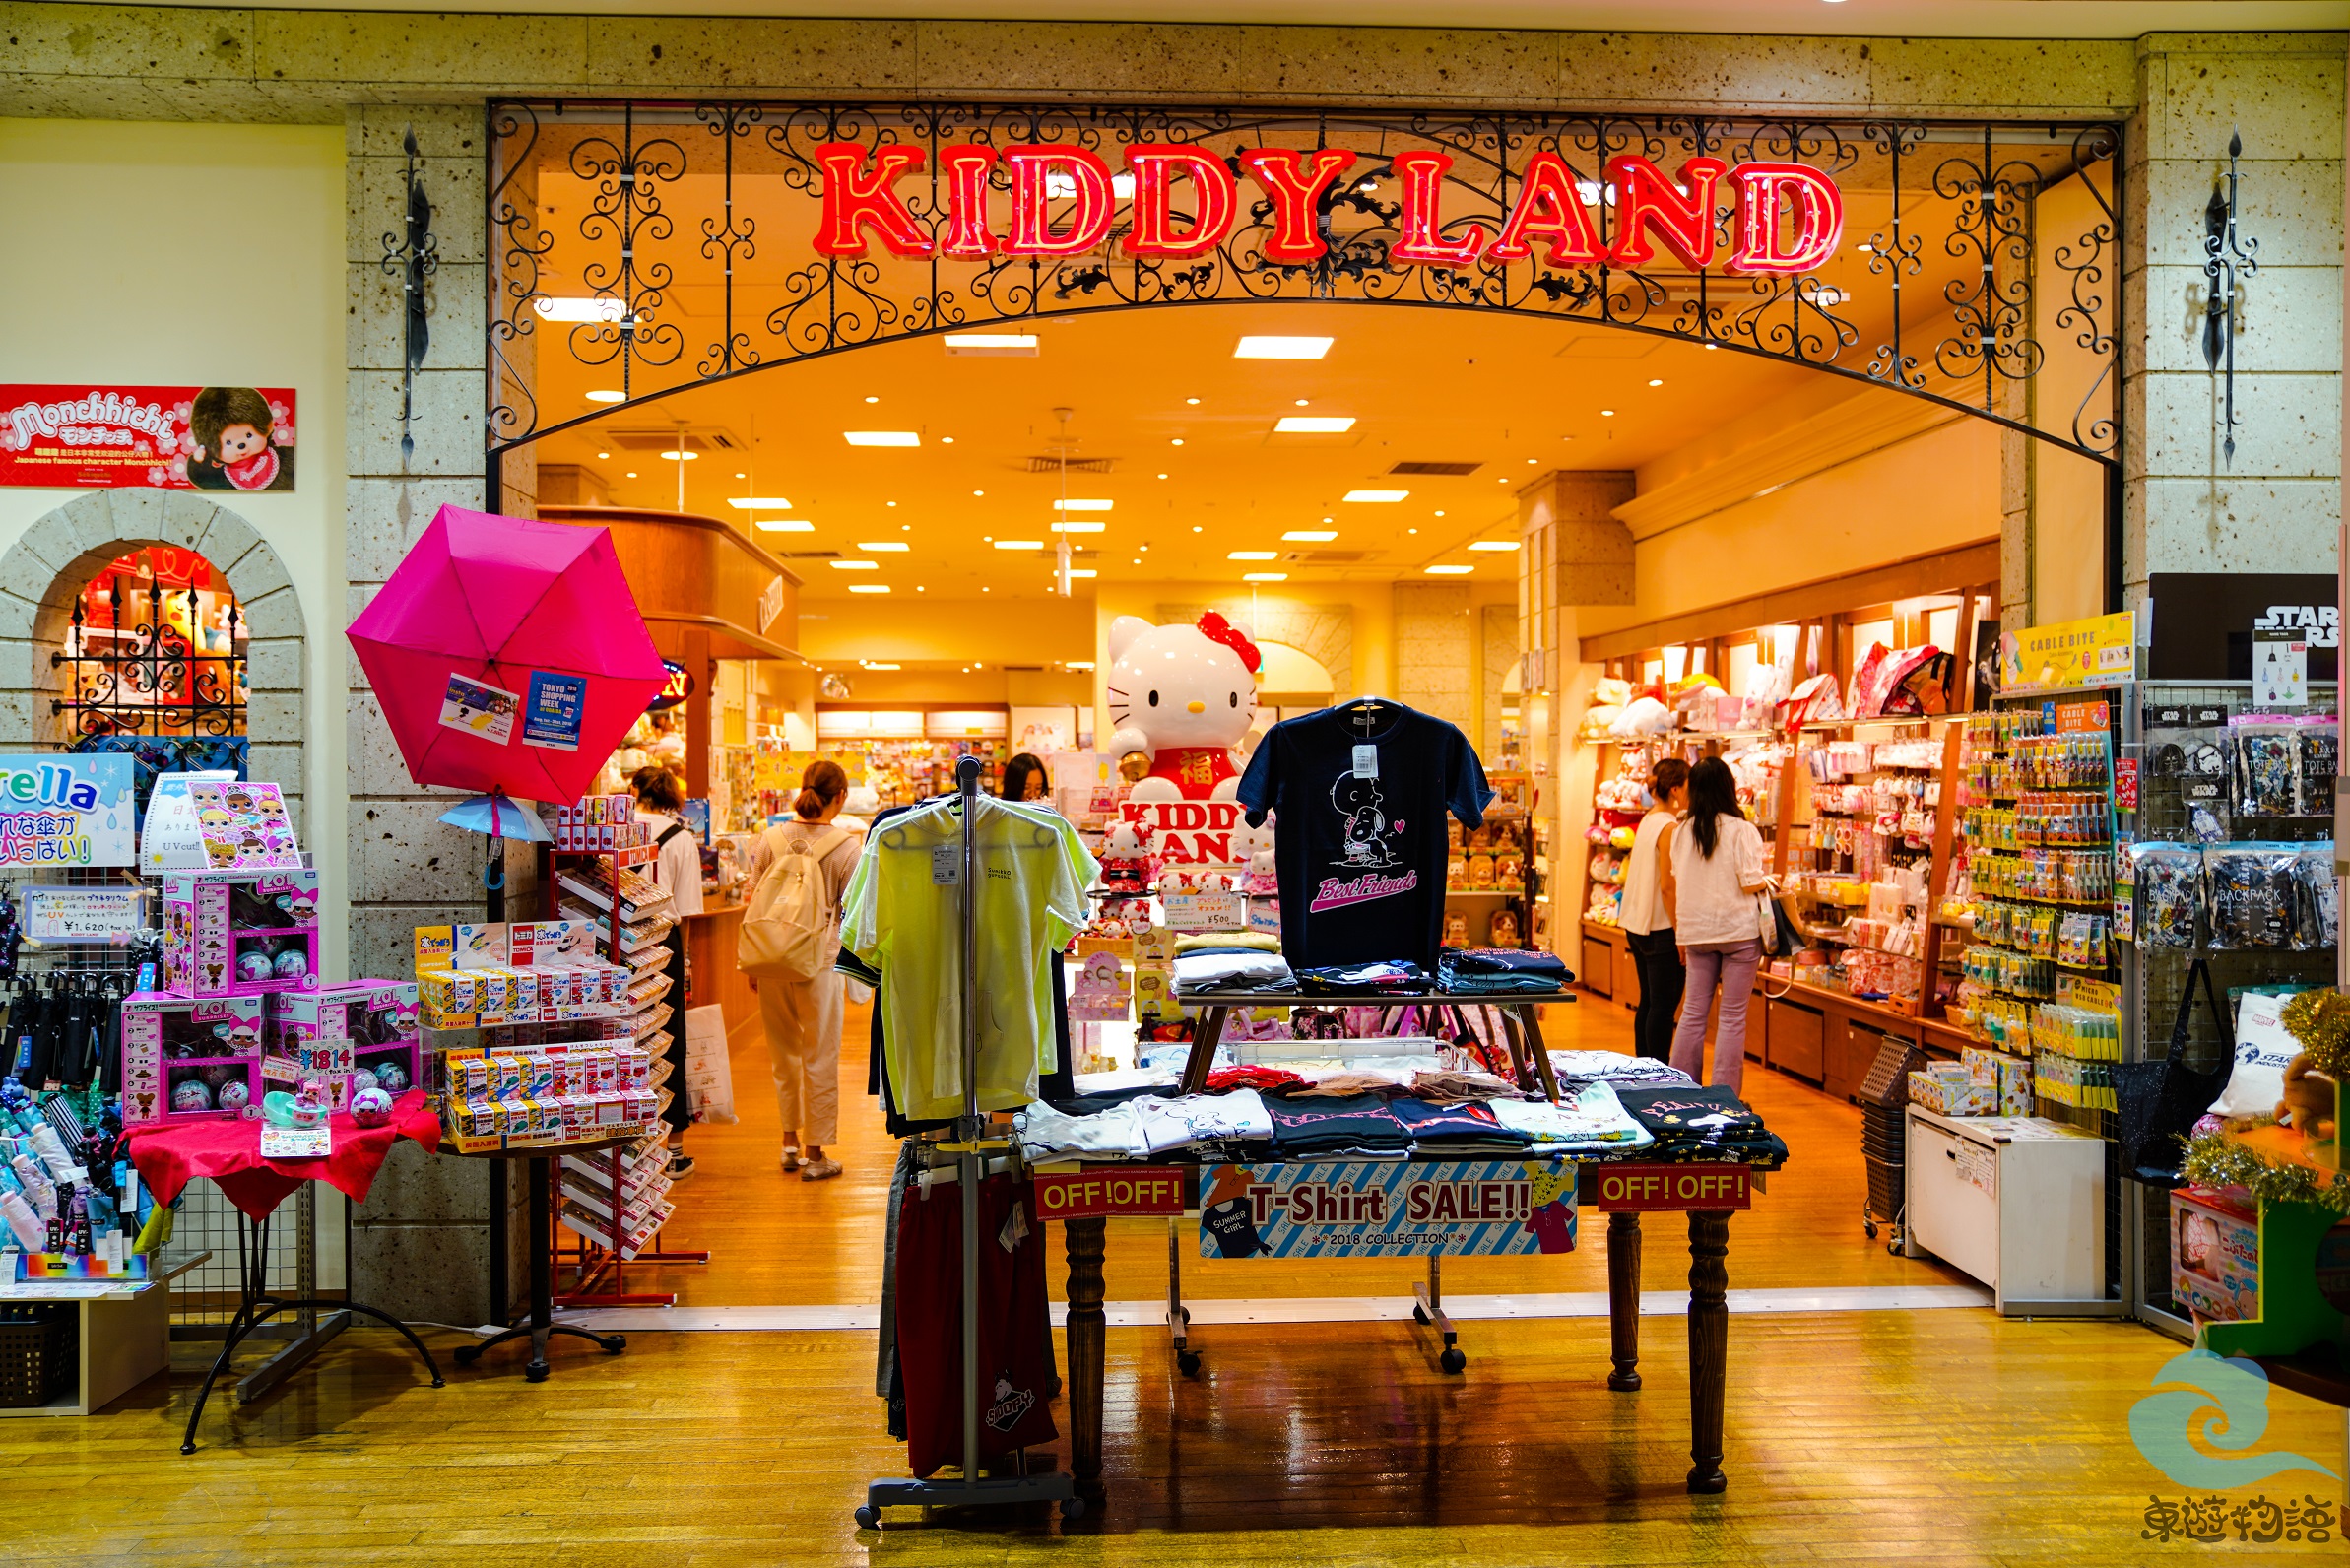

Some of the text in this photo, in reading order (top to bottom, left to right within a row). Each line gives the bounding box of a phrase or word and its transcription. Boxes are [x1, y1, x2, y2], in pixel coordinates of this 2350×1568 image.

[812, 143, 1845, 277] KIDDY LAND
[11, 392, 175, 450] Monchhichi
[60, 427, 133, 445] モンチッチ
[2254, 606, 2338, 627] STAR
[2030, 631, 2095, 652] CABLE BITE
[2254, 626, 2338, 647] RS
[541, 691, 576, 703] SHOPPING
[542, 684, 565, 693] TOKYO
[540, 699, 559, 708] WEEK
[2061, 709, 2085, 718] CABLE
[2065, 718, 2082, 727] BITE
[1180, 751, 1212, 784] 福
[2305, 760, 2324, 770] TOTE
[1121, 803, 1249, 830] KIDD
[262, 873, 296, 887] LOL
[1317, 870, 1418, 900] Best Friends
[2148, 889, 2192, 902] BACKPAC
[2219, 889, 2281, 902] BACKPACK
[1208, 915, 1229, 924] ¥500
[514, 931, 533, 941] トミカ
[537, 929, 562, 940] 水でっぽう
[373, 989, 400, 1005] LOL
[2081, 986, 2098, 996] MICRO
[197, 1001, 234, 1016] LOL
[2086, 996, 2104, 1006] CABLE
[300, 1049, 352, 1070] ¥1814
[2260, 1054, 2293, 1064] STAR
[1280, 1165, 1297, 1185] SALE
[1405, 1164, 1421, 1184] SALE
[1044, 1180, 1179, 1209] OFF! OFF!
[1602, 1175, 1743, 1200] OFF! OFF!
[1248, 1183, 1530, 1222] T-Shirt SALE!!
[1389, 1189, 1404, 1209] SALE
[1212, 1210, 1246, 1229] SUMMER
[1293, 1239, 1309, 1258] SALE
[1330, 1233, 1449, 1246] 2018 COLLECTION
[1478, 1237, 1494, 1256] SALE
[1509, 1236, 1525, 1255] SALE
[987, 1389, 1033, 1426] SNOOPY
